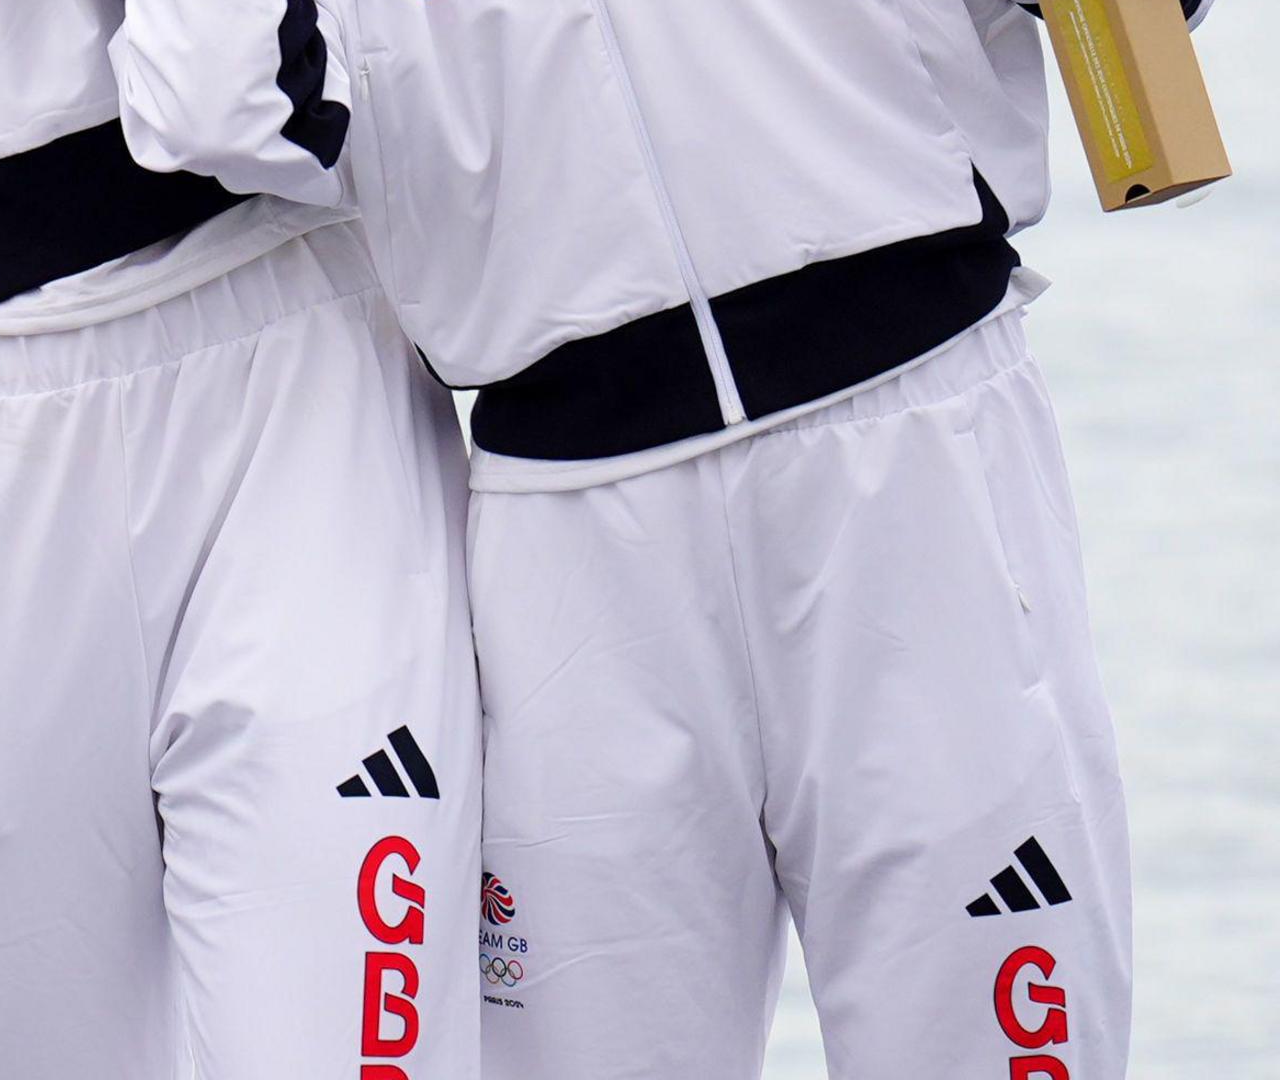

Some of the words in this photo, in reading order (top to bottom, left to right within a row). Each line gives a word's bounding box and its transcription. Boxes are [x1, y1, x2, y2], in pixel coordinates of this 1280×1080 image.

[356, 835, 425, 1080] GB
[478, 929, 503, 949] EAM
[507, 936, 528, 953] GB
